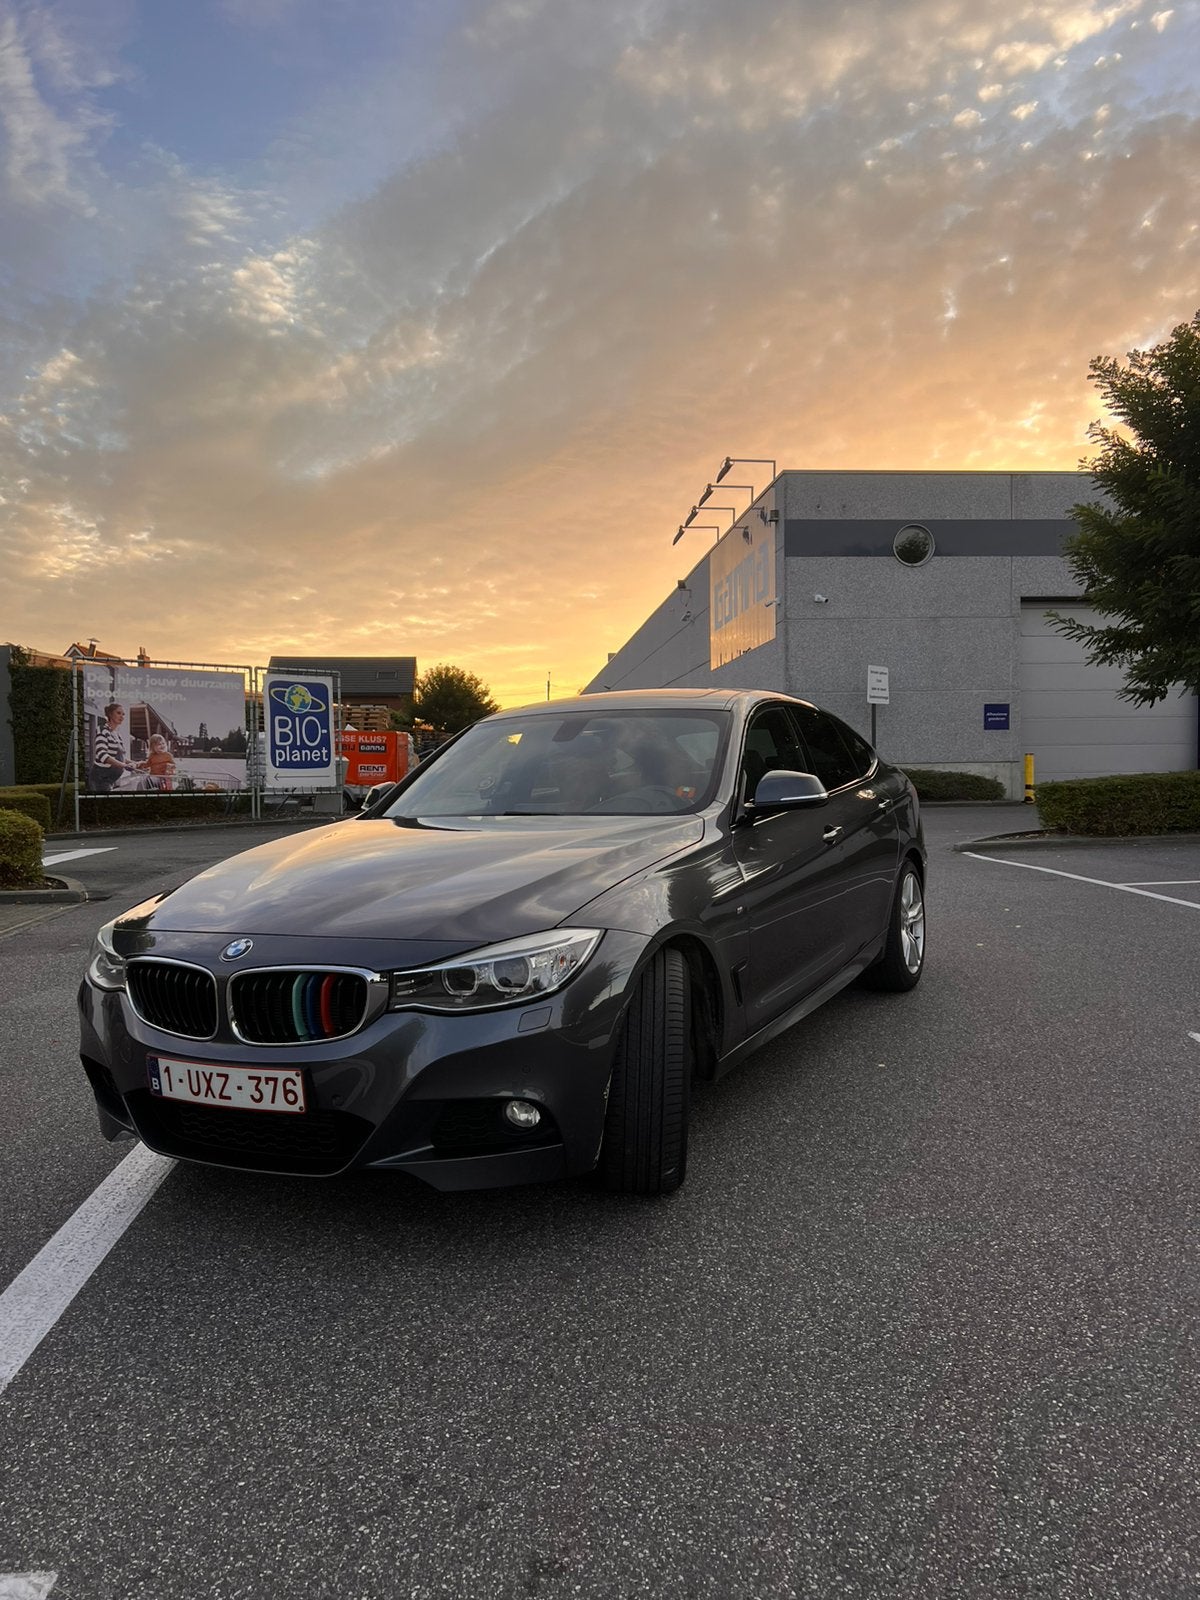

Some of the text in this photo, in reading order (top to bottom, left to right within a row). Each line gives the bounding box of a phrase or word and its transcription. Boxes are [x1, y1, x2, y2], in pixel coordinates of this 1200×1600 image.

[117, 673, 143, 685] hier
[144, 674, 178, 688] jouw
[181, 678, 241, 690] duurzame
[87, 687, 186, 701] boodschappen.
[358, 735, 387, 743] KLUS?
[275, 745, 328, 767] planet
[152, 1065, 299, 1106] B 1-UXZ-376
